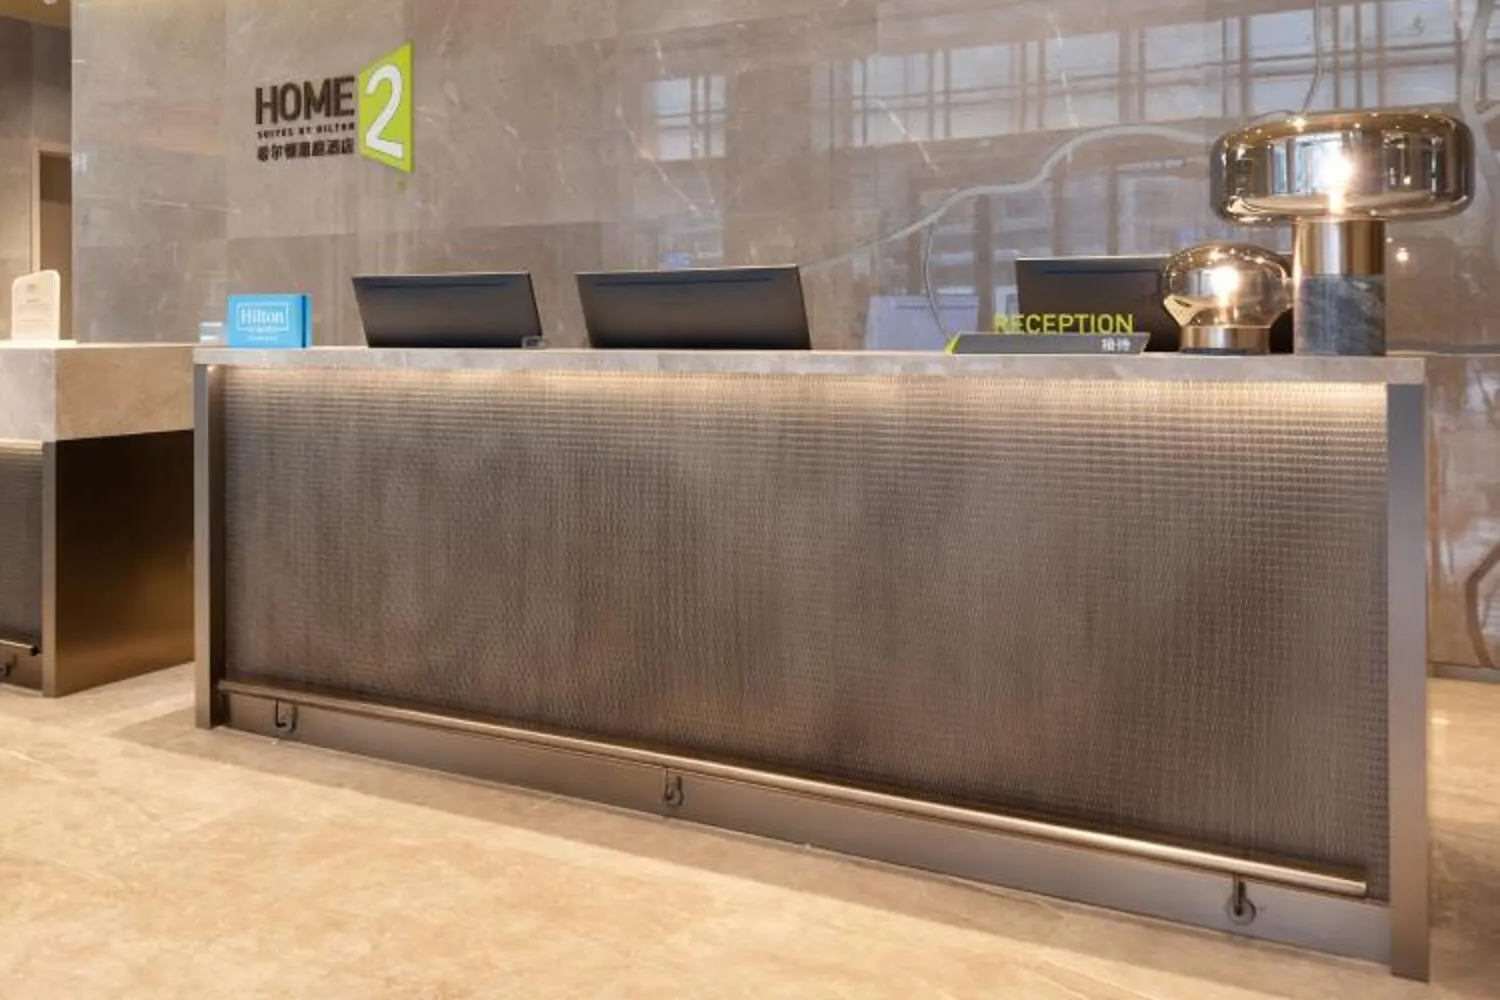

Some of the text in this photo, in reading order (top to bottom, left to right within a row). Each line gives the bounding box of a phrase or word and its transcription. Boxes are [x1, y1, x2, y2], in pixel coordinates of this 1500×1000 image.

[255, 64, 404, 159] HOME 2
[241, 308, 285, 325] Hilton
[993, 313, 1134, 335] RECEPTION
